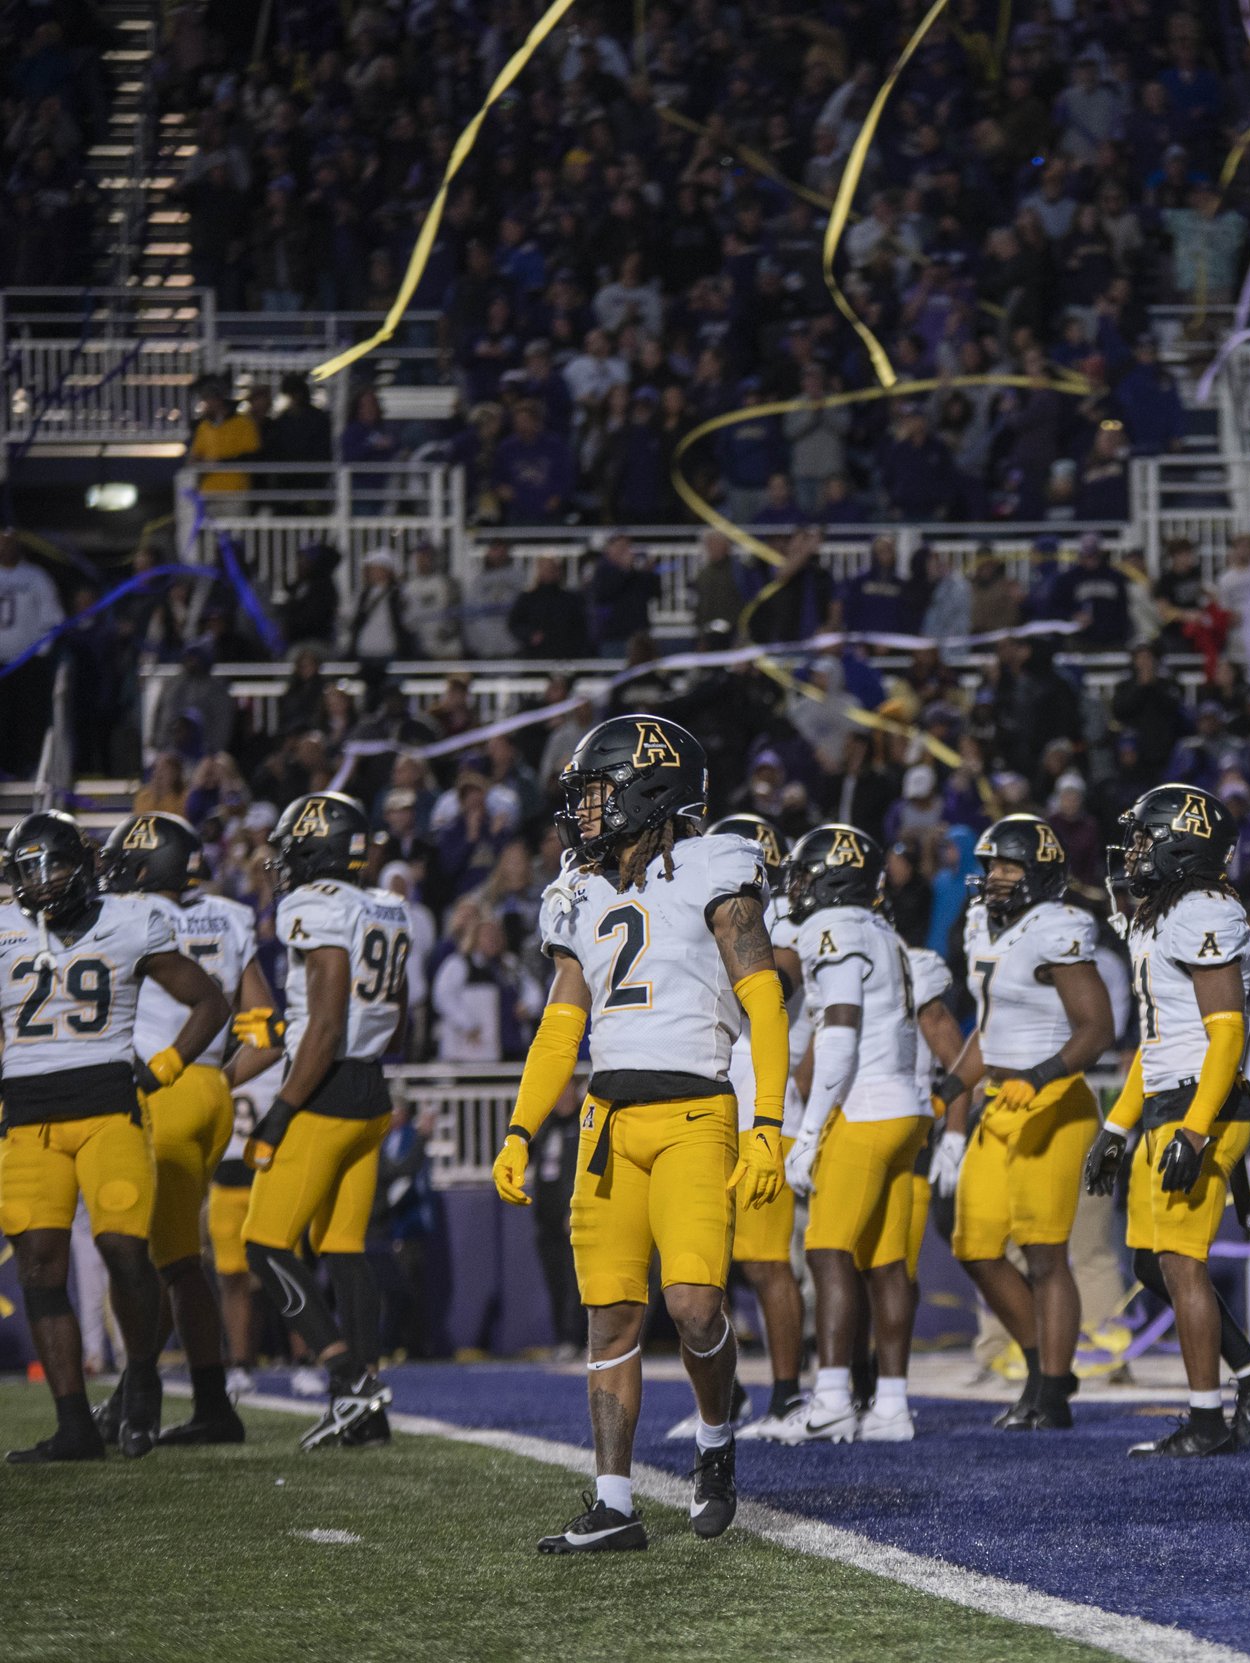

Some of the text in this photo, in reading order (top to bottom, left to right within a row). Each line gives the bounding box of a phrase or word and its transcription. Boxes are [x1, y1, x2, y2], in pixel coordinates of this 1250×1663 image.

[632, 722, 680, 768] A
[123, 815, 158, 850] A
[293, 799, 329, 837] A
[1172, 794, 1211, 839] A
[826, 831, 865, 869] A
[1036, 824, 1065, 863] A
[288, 917, 311, 941] A
[818, 930, 839, 956] A
[1198, 931, 1222, 958] A
[594, 899, 653, 1015] 2
[9, 952, 116, 1043] 29
[972, 955, 1001, 1037] 7
[582, 1104, 596, 1130] A
